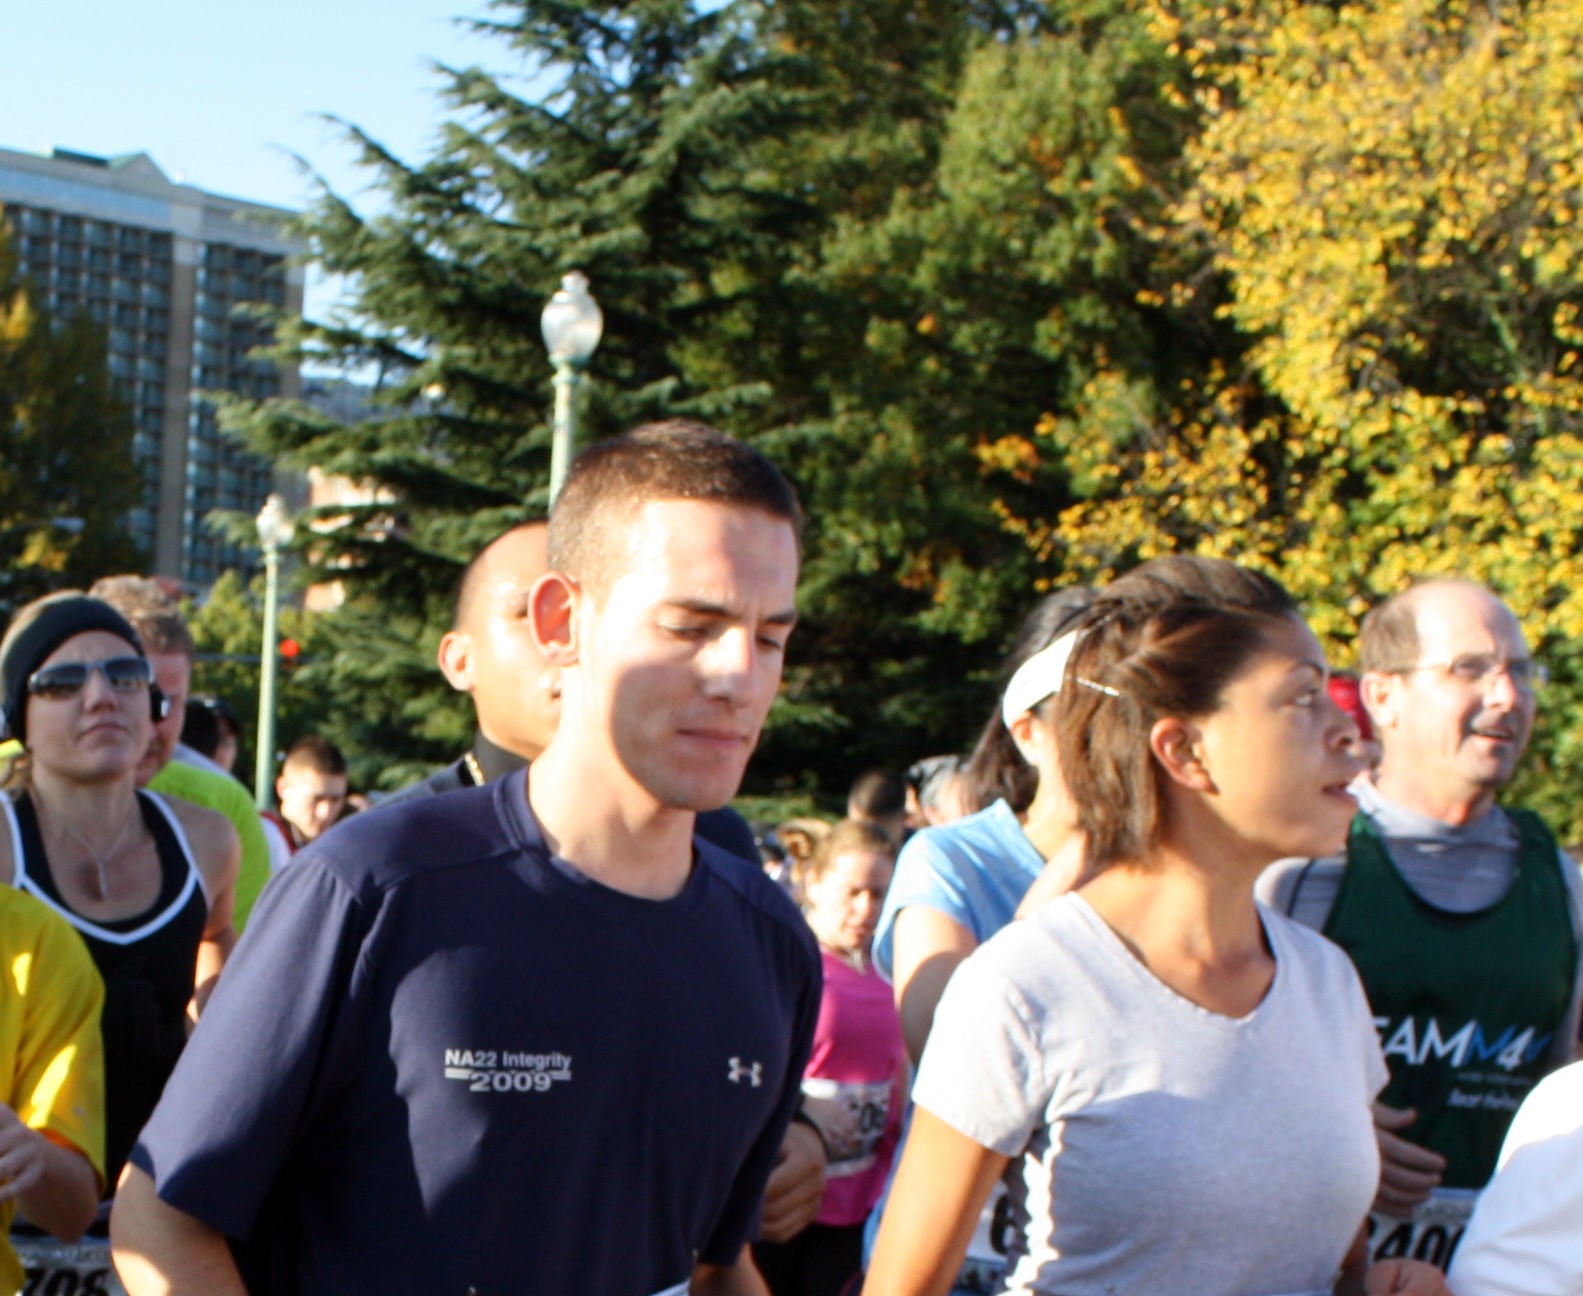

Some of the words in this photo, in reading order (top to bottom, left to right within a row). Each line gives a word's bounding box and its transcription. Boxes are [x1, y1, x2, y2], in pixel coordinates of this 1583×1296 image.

[444, 1048, 497, 1067] NA22
[502, 1050, 572, 1069] Integrity
[469, 1071, 553, 1092] 2009
